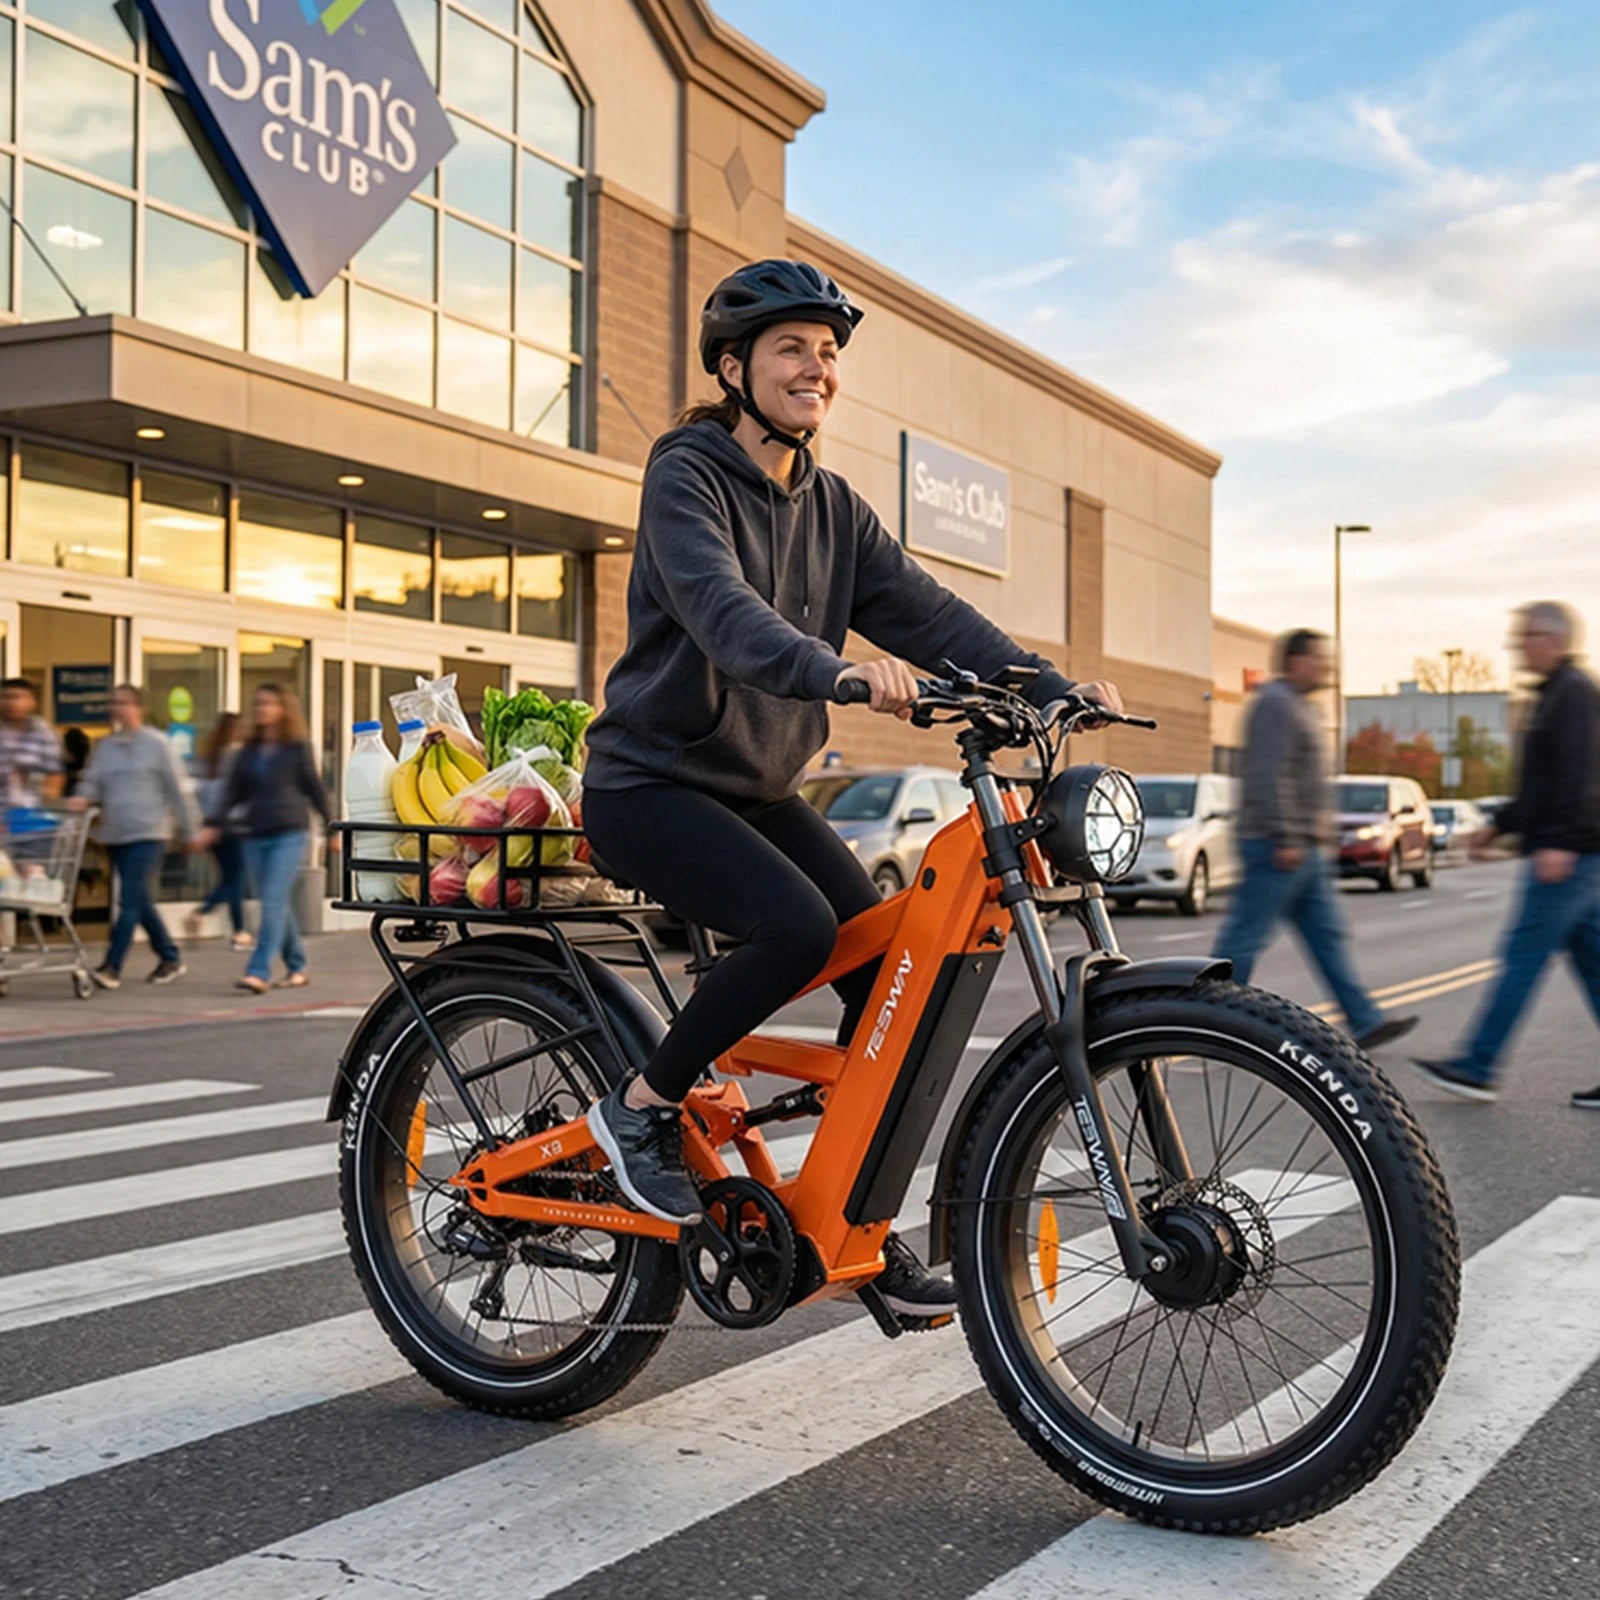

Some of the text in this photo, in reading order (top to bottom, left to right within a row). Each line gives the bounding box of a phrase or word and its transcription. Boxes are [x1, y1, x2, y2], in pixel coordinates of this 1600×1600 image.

[208, 0, 417, 173] Sam's
[914, 461, 1005, 529] Sam's Club
[864, 949, 913, 1060] TESWAY
[345, 1053, 382, 1150] KENDA
[1278, 1040, 1372, 1140] KENDA
